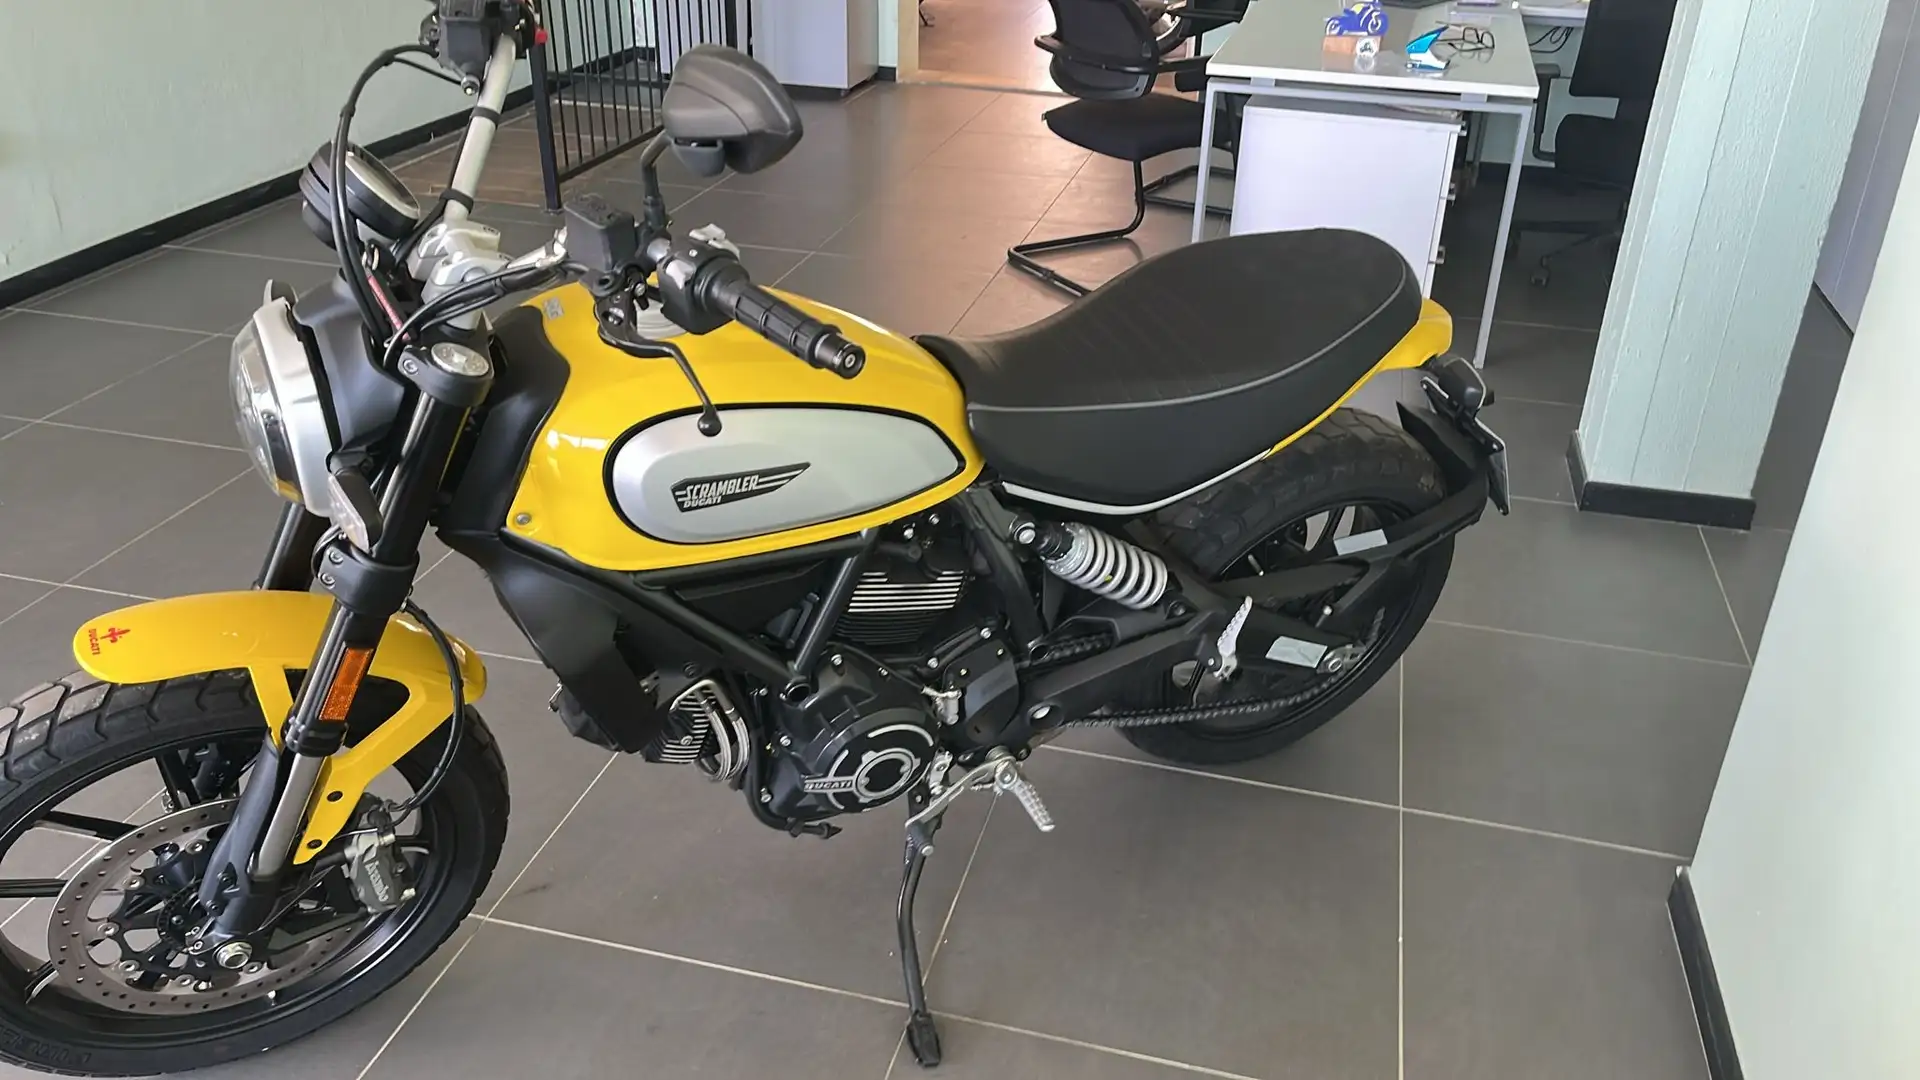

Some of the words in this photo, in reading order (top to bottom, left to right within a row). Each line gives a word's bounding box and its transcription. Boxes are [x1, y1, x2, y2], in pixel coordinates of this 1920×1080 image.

[682, 474, 760, 501] SCRAMBLER
[683, 495, 723, 509] DUCATI
[88, 628, 101, 655] DUCATI
[804, 780, 852, 790] DUCATI
